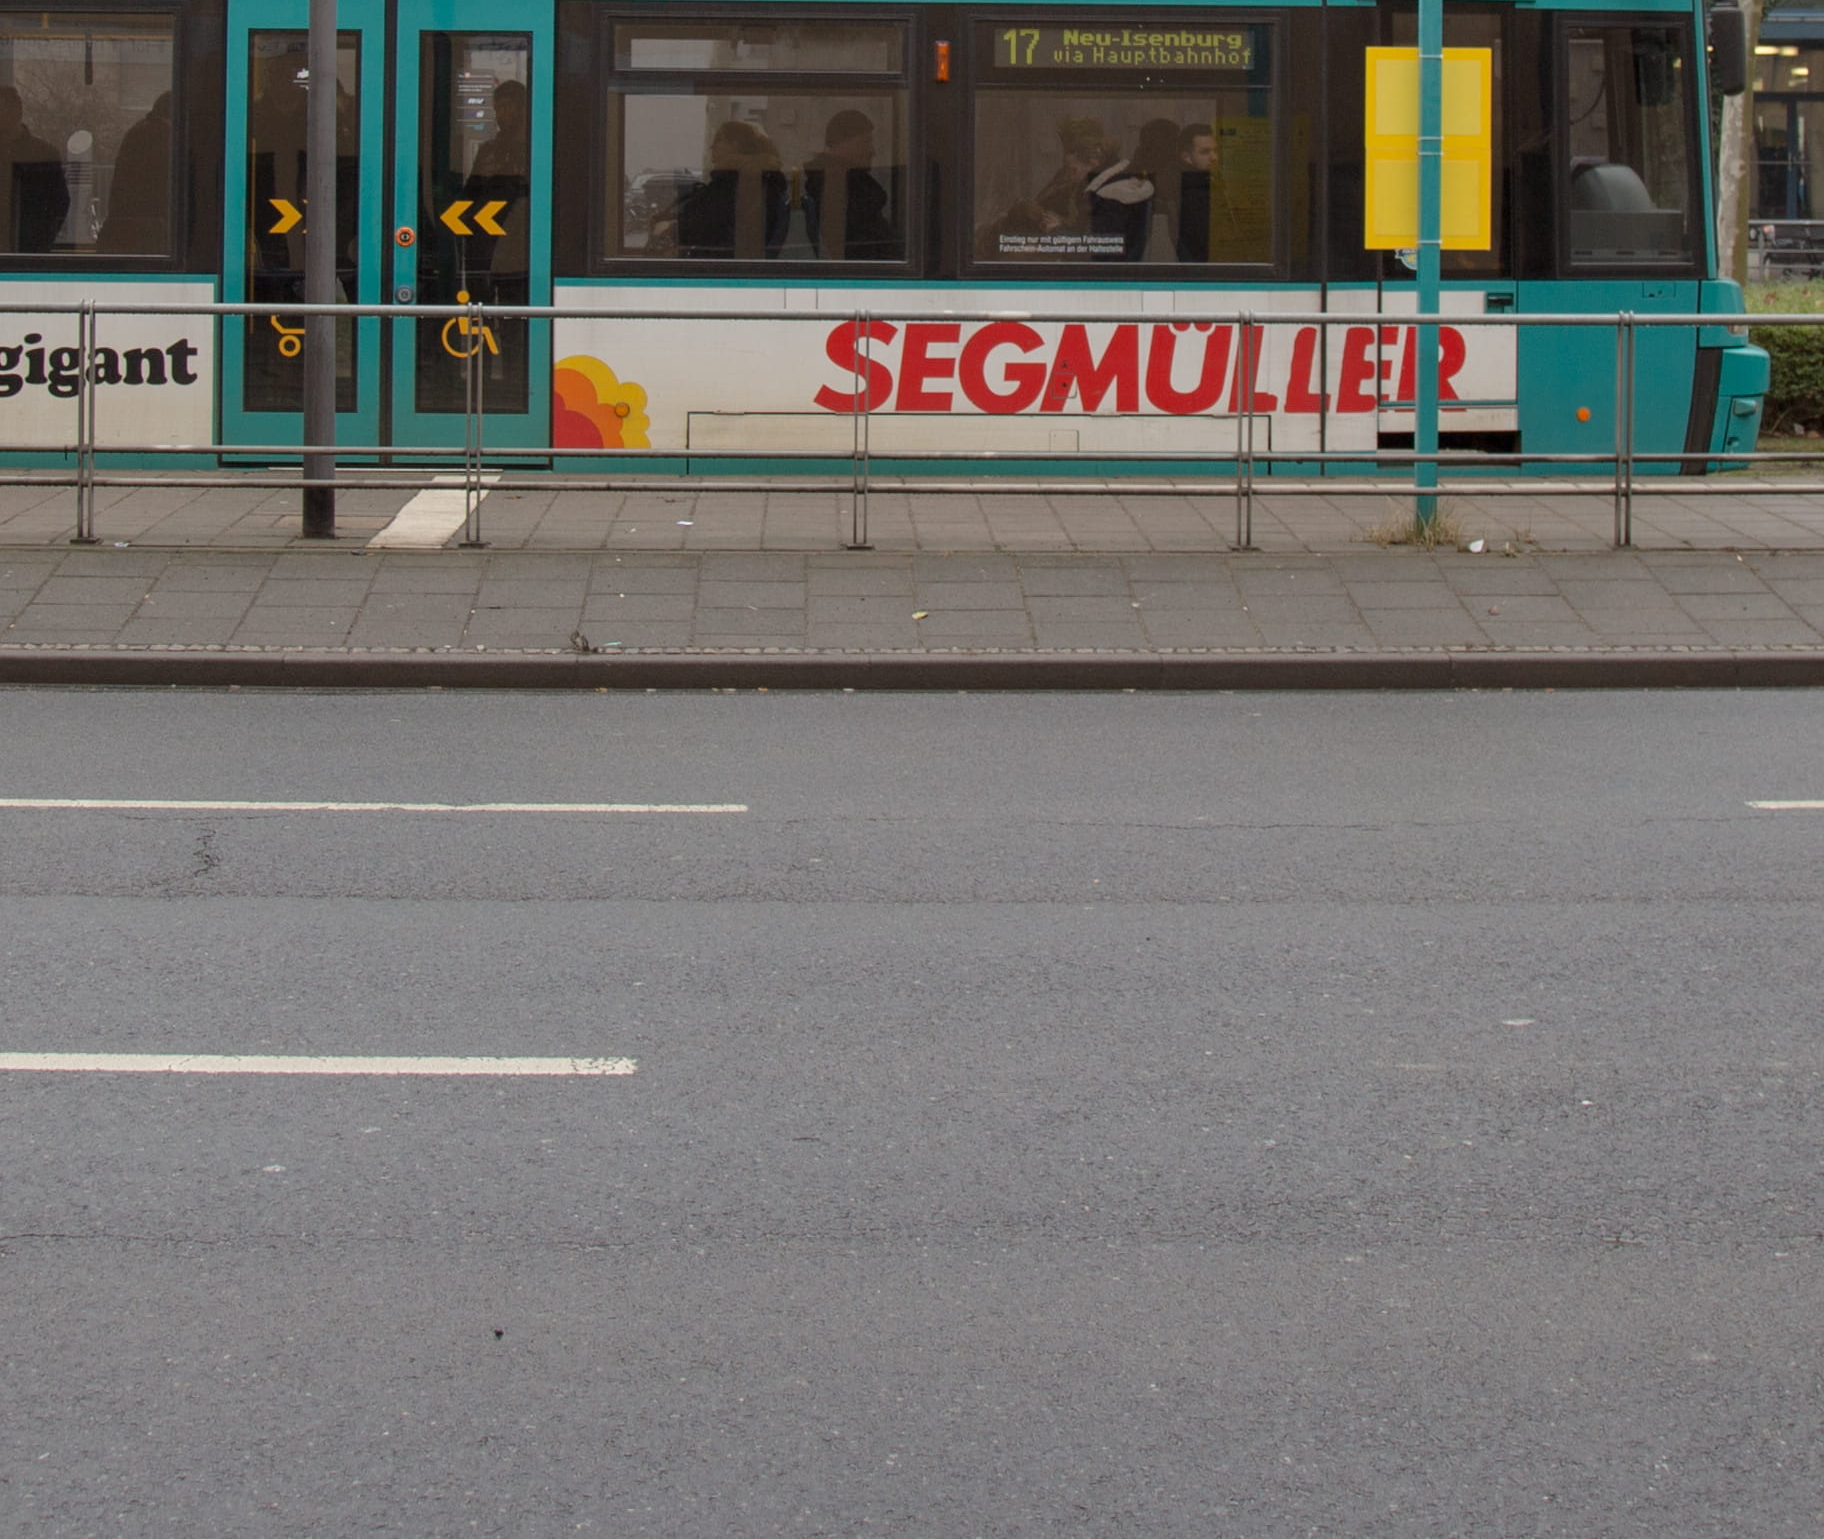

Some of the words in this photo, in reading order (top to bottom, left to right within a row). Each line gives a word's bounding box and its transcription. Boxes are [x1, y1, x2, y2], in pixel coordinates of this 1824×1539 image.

[1003, 28, 1040, 65] 17
[1063, 29, 1242, 49] Neu-Isenburg
[1053, 49, 1084, 63] via
[1093, 48, 1251, 66] Hauptbahnhof
[999, 234, 1026, 244] Einstieg
[1040, 235, 1051, 243] mit
[1083, 234, 1124, 244] Fahrausweis
[1089, 244, 1124, 253] Haltestelle
[813, 321, 1467, 414] SEGMÜLLER
